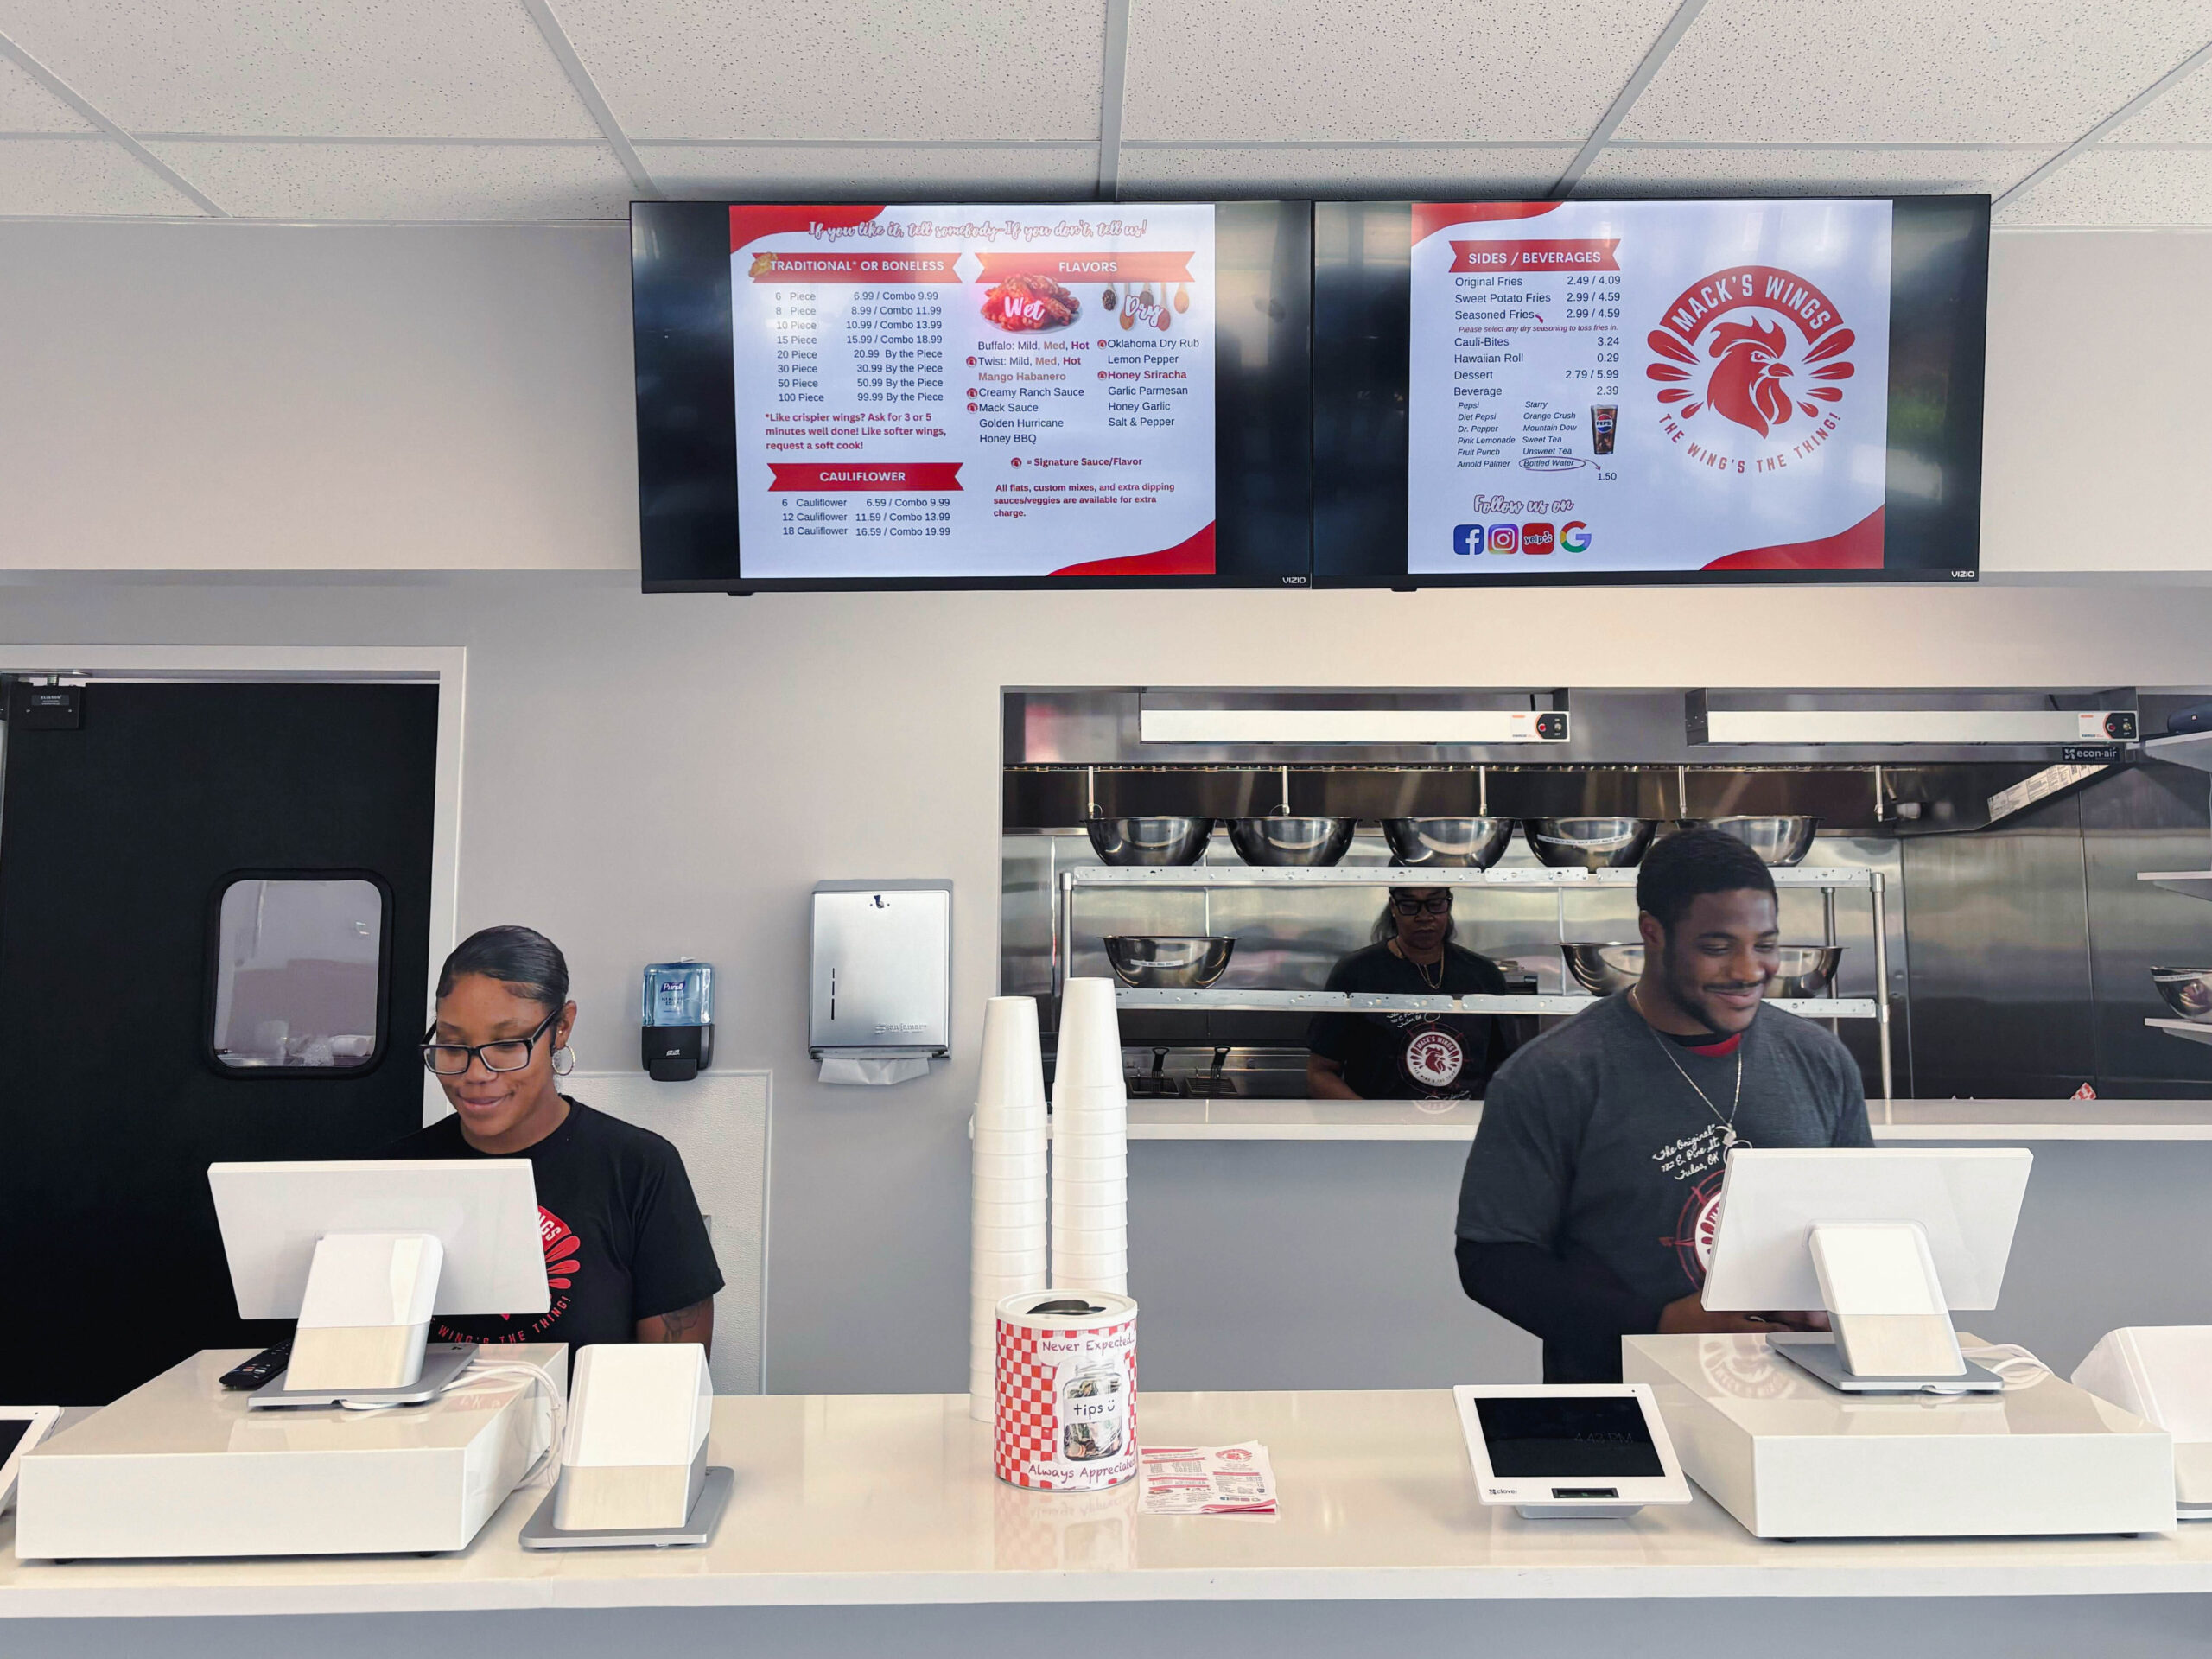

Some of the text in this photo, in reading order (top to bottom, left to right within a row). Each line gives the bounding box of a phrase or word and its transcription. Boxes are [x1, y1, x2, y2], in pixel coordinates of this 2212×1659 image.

[809, 221, 824, 240] If
[827, 227, 856, 242] you
[858, 221, 885, 238] like
[908, 221, 932, 237] tell
[1024, 227, 1052, 242] you
[1096, 220, 1122, 237] tell
[1124, 219, 1147, 238] us!
[1469, 252, 1508, 264] SIDES
[1522, 251, 1601, 264] BEVERAGES
[861, 261, 879, 270] OR
[882, 260, 944, 270] BONELESS
[1058, 262, 1118, 272] FLAVORS
[1455, 294, 1486, 303] Sweet
[1490, 294, 1522, 302] Potato
[1526, 293, 1551, 302] Fries
[1567, 292, 1589, 302] 2.99
[1598, 292, 1621, 302] 4.59
[1671, 273, 1831, 333] MACK'S WINGS
[1004, 296, 1046, 321] Wet
[1125, 295, 1164, 327] Dry
[791, 335, 817, 345] Piece
[847, 335, 873, 344] 15.99
[880, 335, 913, 345] Combo
[916, 335, 943, 344] 18.99
[1108, 339, 1199, 350] Oklahoma Dry Rub
[1454, 337, 1619, 346] Cauli-Bites 3.24
[978, 341, 1090, 352] Buffalo: Mild, Med, Hot
[1108, 354, 1179, 366] Lemon Pepper
[1454, 353, 1619, 364] Hawaiian Roll 0.29
[978, 372, 1066, 384] Mango Habanero
[1108, 370, 1187, 382] Honey Sriracha
[979, 387, 1084, 399] Creamy Ranch Sauce
[1108, 386, 1188, 396] Garlic Parmesan
[779, 392, 944, 404] 100 Piece 99.99 By the Piece
[1458, 402, 1479, 410] Pepsi
[792, 413, 830, 423] crispier
[832, 413, 865, 423] wings?
[868, 413, 886, 422] Ask
[887, 413, 902, 422] for
[905, 413, 910, 422] 3
[925, 413, 931, 422] 5
[979, 418, 1064, 428] Golden Hurricane
[1108, 417, 1174, 429] Salt & Pepper
[766, 427, 946, 437] minutes well done! Like softer wings,
[979, 434, 1037, 446] Honey BBQ
[1658, 412, 1841, 474] THE WING'S THE THING!
[766, 442, 804, 451] request
[815, 441, 834, 449] soft
[836, 441, 863, 449] cook!
[819, 472, 906, 481] CAULIFLOWER
[1474, 494, 1574, 515] Follow us on
[797, 512, 848, 522] Cauliflower
[1523, 536, 1543, 544] yelp
[499, 1331, 525, 1344] THE
[532, 1295, 571, 1333] THING!
[1042, 1341, 1080, 1351] Never
[1073, 1402, 1103, 1420] tips
[1028, 1465, 1074, 1484] Always
